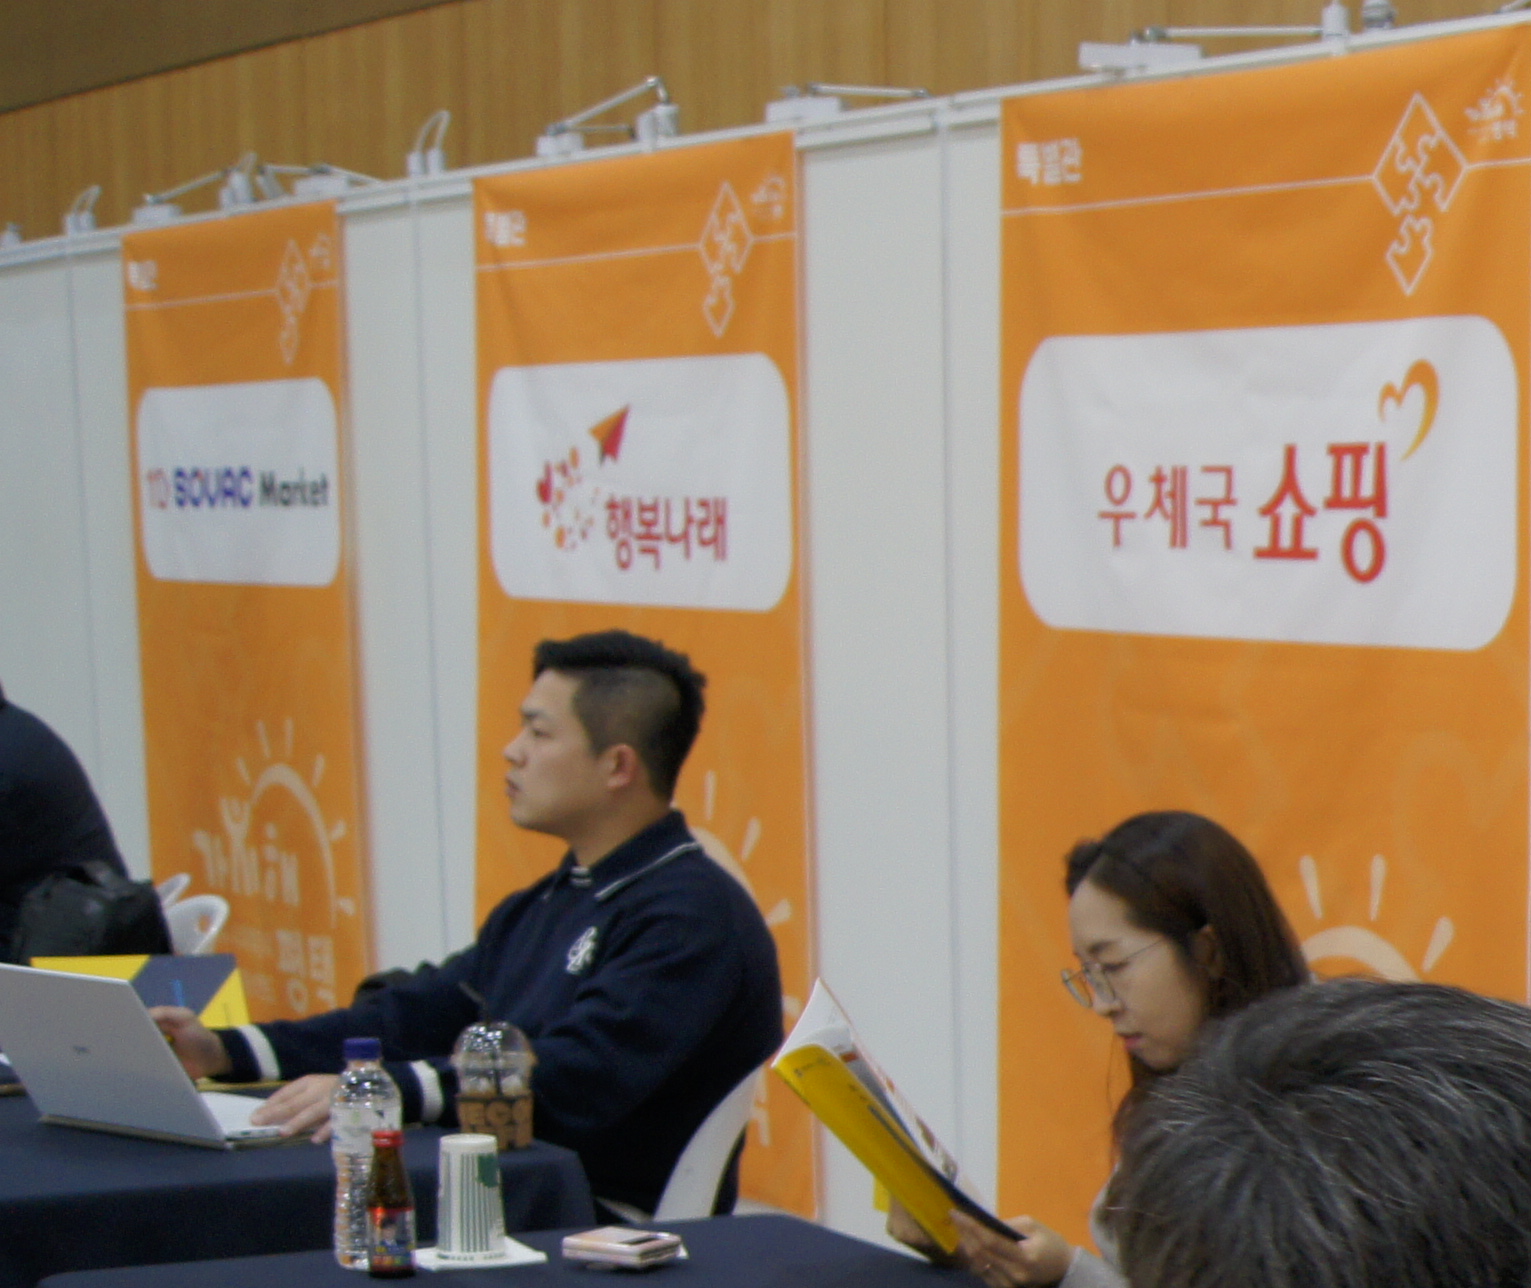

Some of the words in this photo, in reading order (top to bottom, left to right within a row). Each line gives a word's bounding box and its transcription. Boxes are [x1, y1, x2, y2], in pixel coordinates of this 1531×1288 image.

[258, 466, 330, 508] Market
[1098, 463, 1239, 552] 우체국
[1253, 441, 1390, 584] 쇼핑
[604, 497, 729, 572] 행복나래
